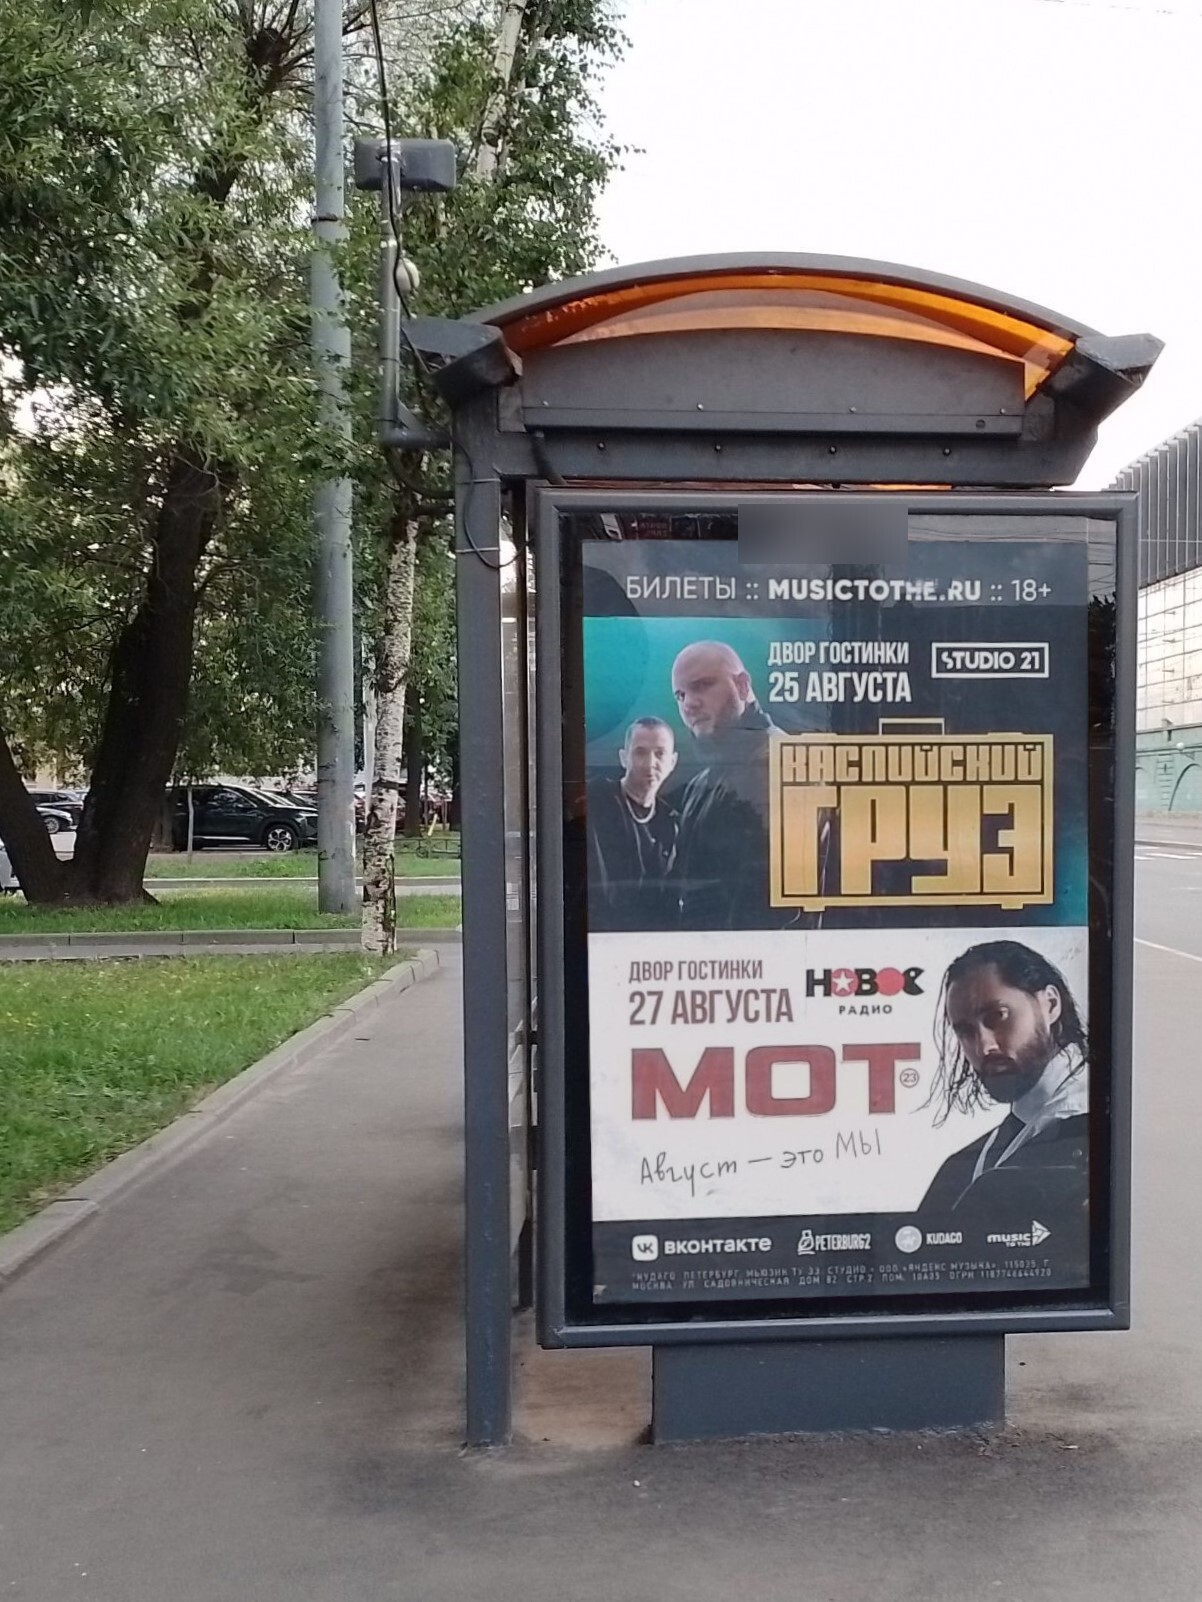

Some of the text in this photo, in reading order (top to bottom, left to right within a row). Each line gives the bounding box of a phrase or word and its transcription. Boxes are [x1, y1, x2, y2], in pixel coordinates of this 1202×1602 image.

[626, 576, 736, 599] БИЛЕТЫ
[768, 579, 981, 601] MUSICTOTHE.RU
[1011, 579, 1051, 601] 18+
[768, 642, 909, 666] ДВОР ГОСТИНКИ
[941, 651, 1040, 669] STUDIO 21
[769, 671, 912, 702] 25 АВГУСТА
[782, 744, 1042, 782] КАСПИЙСКИЙ
[782, 784, 1043, 895] ГРУЗ
[629, 959, 763, 983] ДВОР ГОСТИНКИ
[629, 988, 794, 1025] 27 АВГУСТА
[839, 1004, 893, 1016] РАДИО
[631, 1042, 921, 1121] МОТ
[640, 1152, 737, 1197] Август
[781, 1149, 824, 1169] это
